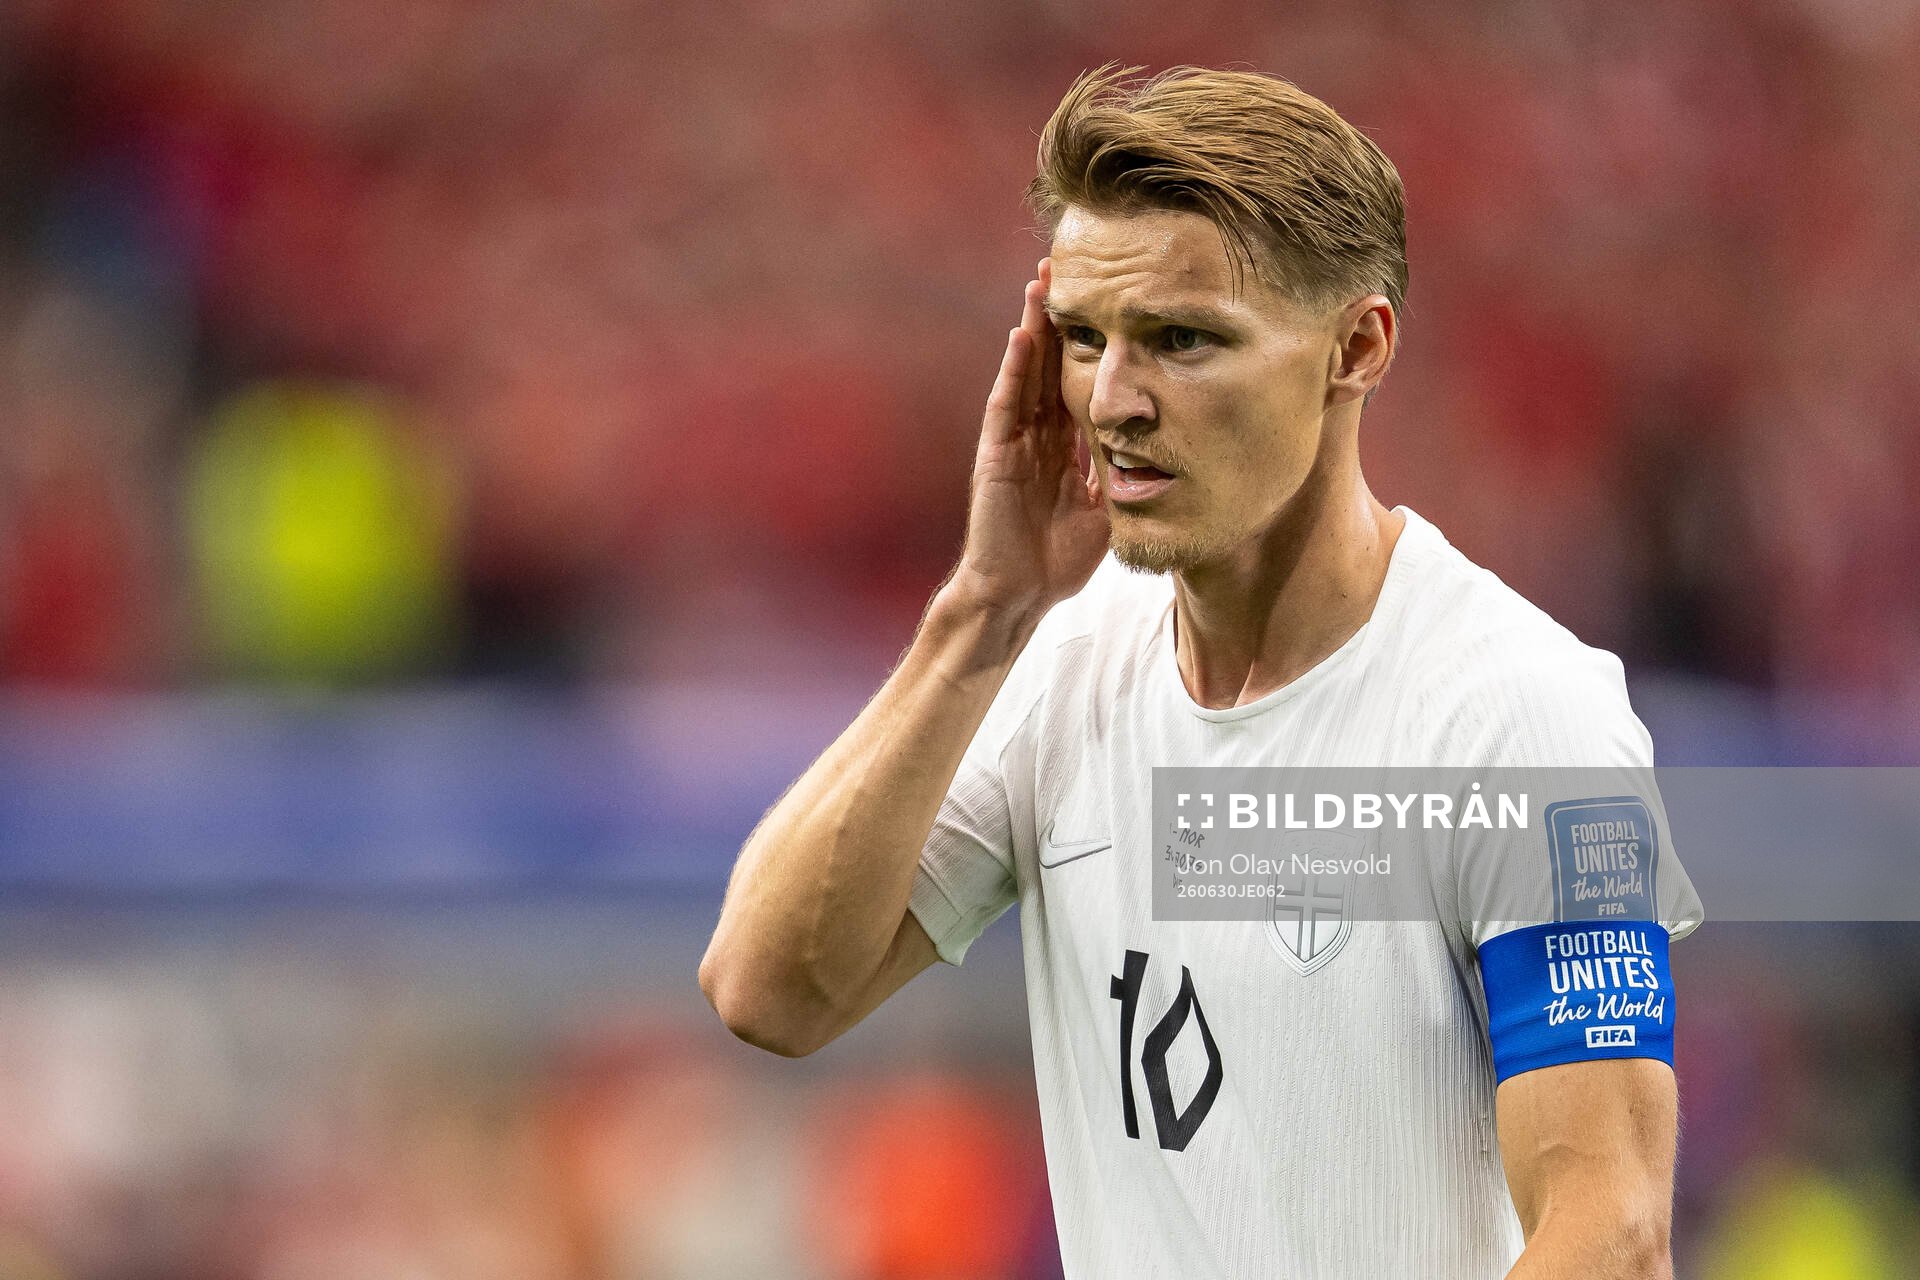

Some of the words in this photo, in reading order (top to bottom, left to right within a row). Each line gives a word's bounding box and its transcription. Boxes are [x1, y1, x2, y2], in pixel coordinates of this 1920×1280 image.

[1570, 820, 1640, 845] FOOTBALL
[1573, 842, 1640, 874] UNITES
[1571, 871, 1601, 902] the
[1602, 870, 1644, 901] World
[1598, 903, 1627, 916] FIFA
[1545, 930, 1652, 959] FOOTBALL
[1548, 957, 1659, 994] UNITES
[1543, 995, 1592, 1026] the
[1596, 991, 1666, 1025] World
[1109, 949, 1224, 1152] 10
[1590, 1027, 1633, 1044] FIFA
